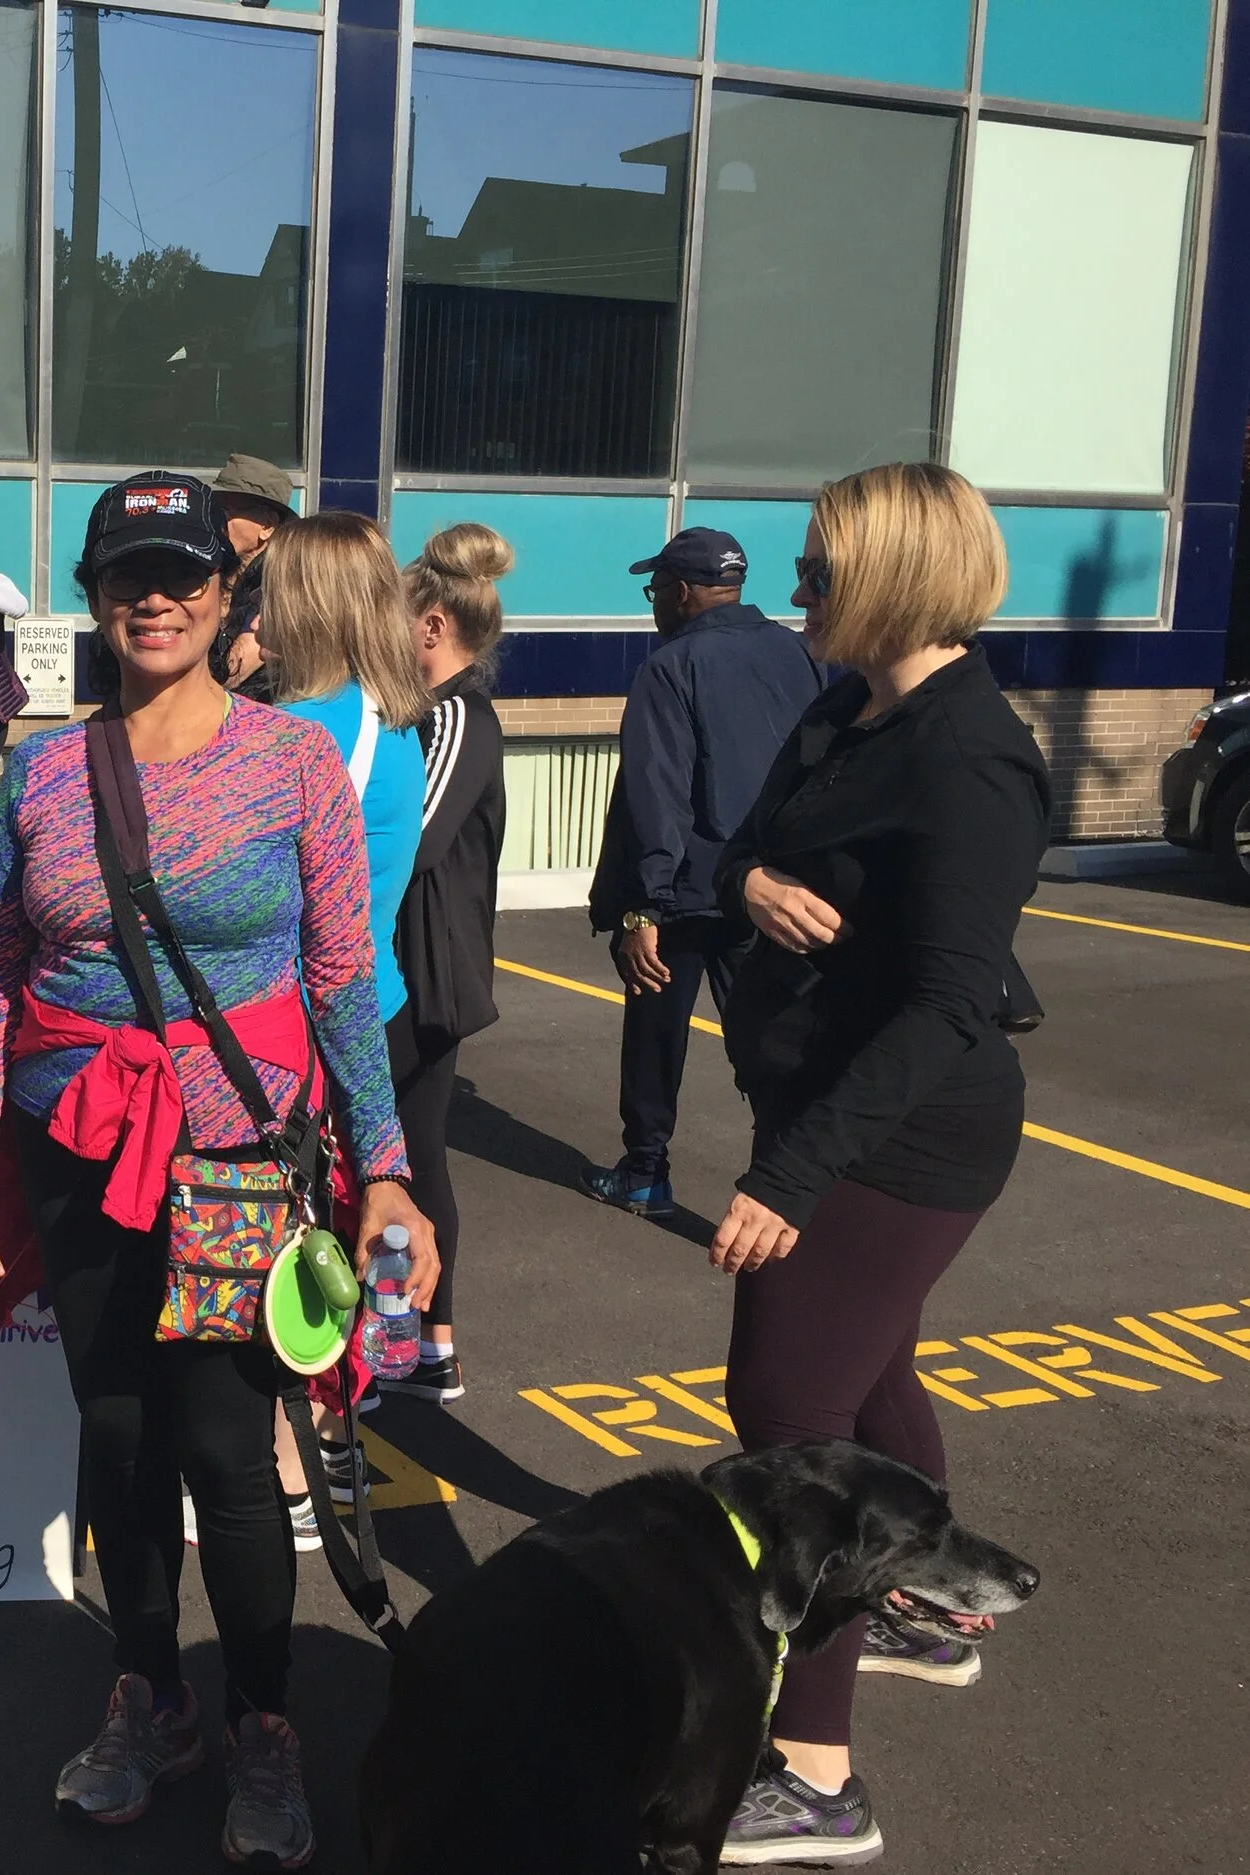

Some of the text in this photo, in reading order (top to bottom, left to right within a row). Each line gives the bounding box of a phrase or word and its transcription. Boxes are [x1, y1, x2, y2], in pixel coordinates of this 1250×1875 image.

[19, 627, 70, 639] RESERVED
[21, 642, 68, 655] PARKING
[31, 658, 58, 670] ONLY
[0, 1319, 59, 1343] rive
[516, 1298, 1250, 1458] REERVE
